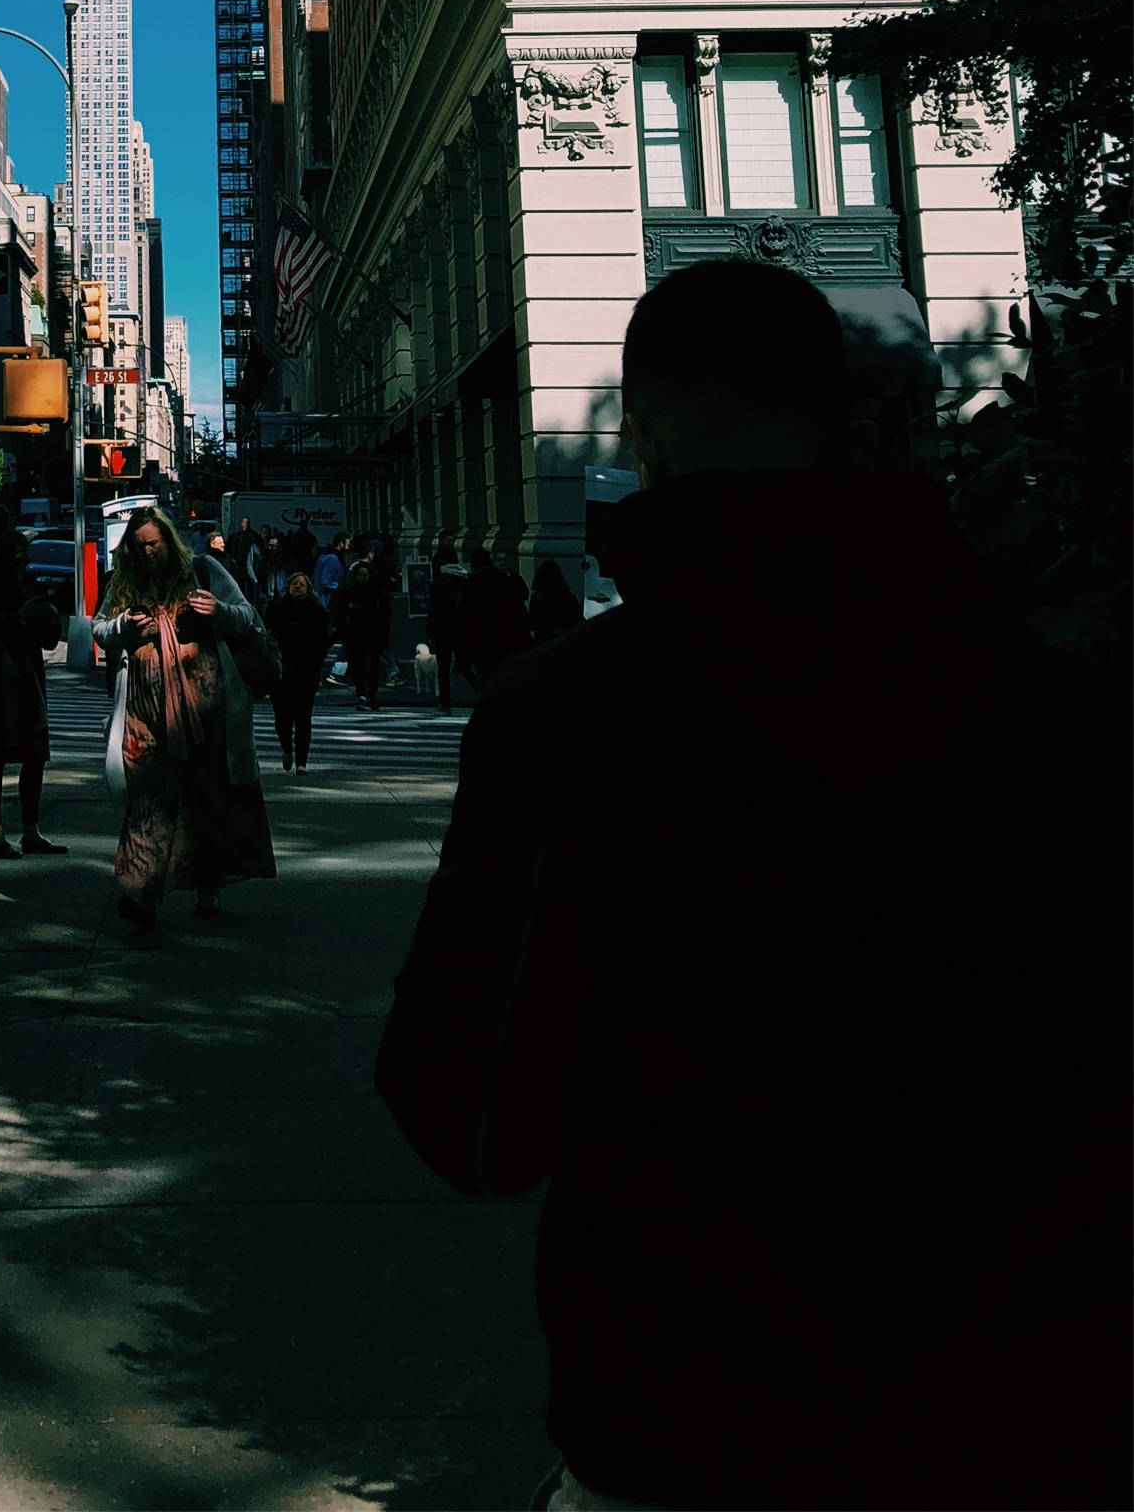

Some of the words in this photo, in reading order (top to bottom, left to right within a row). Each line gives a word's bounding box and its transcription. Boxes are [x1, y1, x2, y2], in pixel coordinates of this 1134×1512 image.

[94, 371, 101, 383] E
[103, 371, 115, 383] 26
[118, 371, 128, 383] St
[294, 508, 337, 523] Ryder
